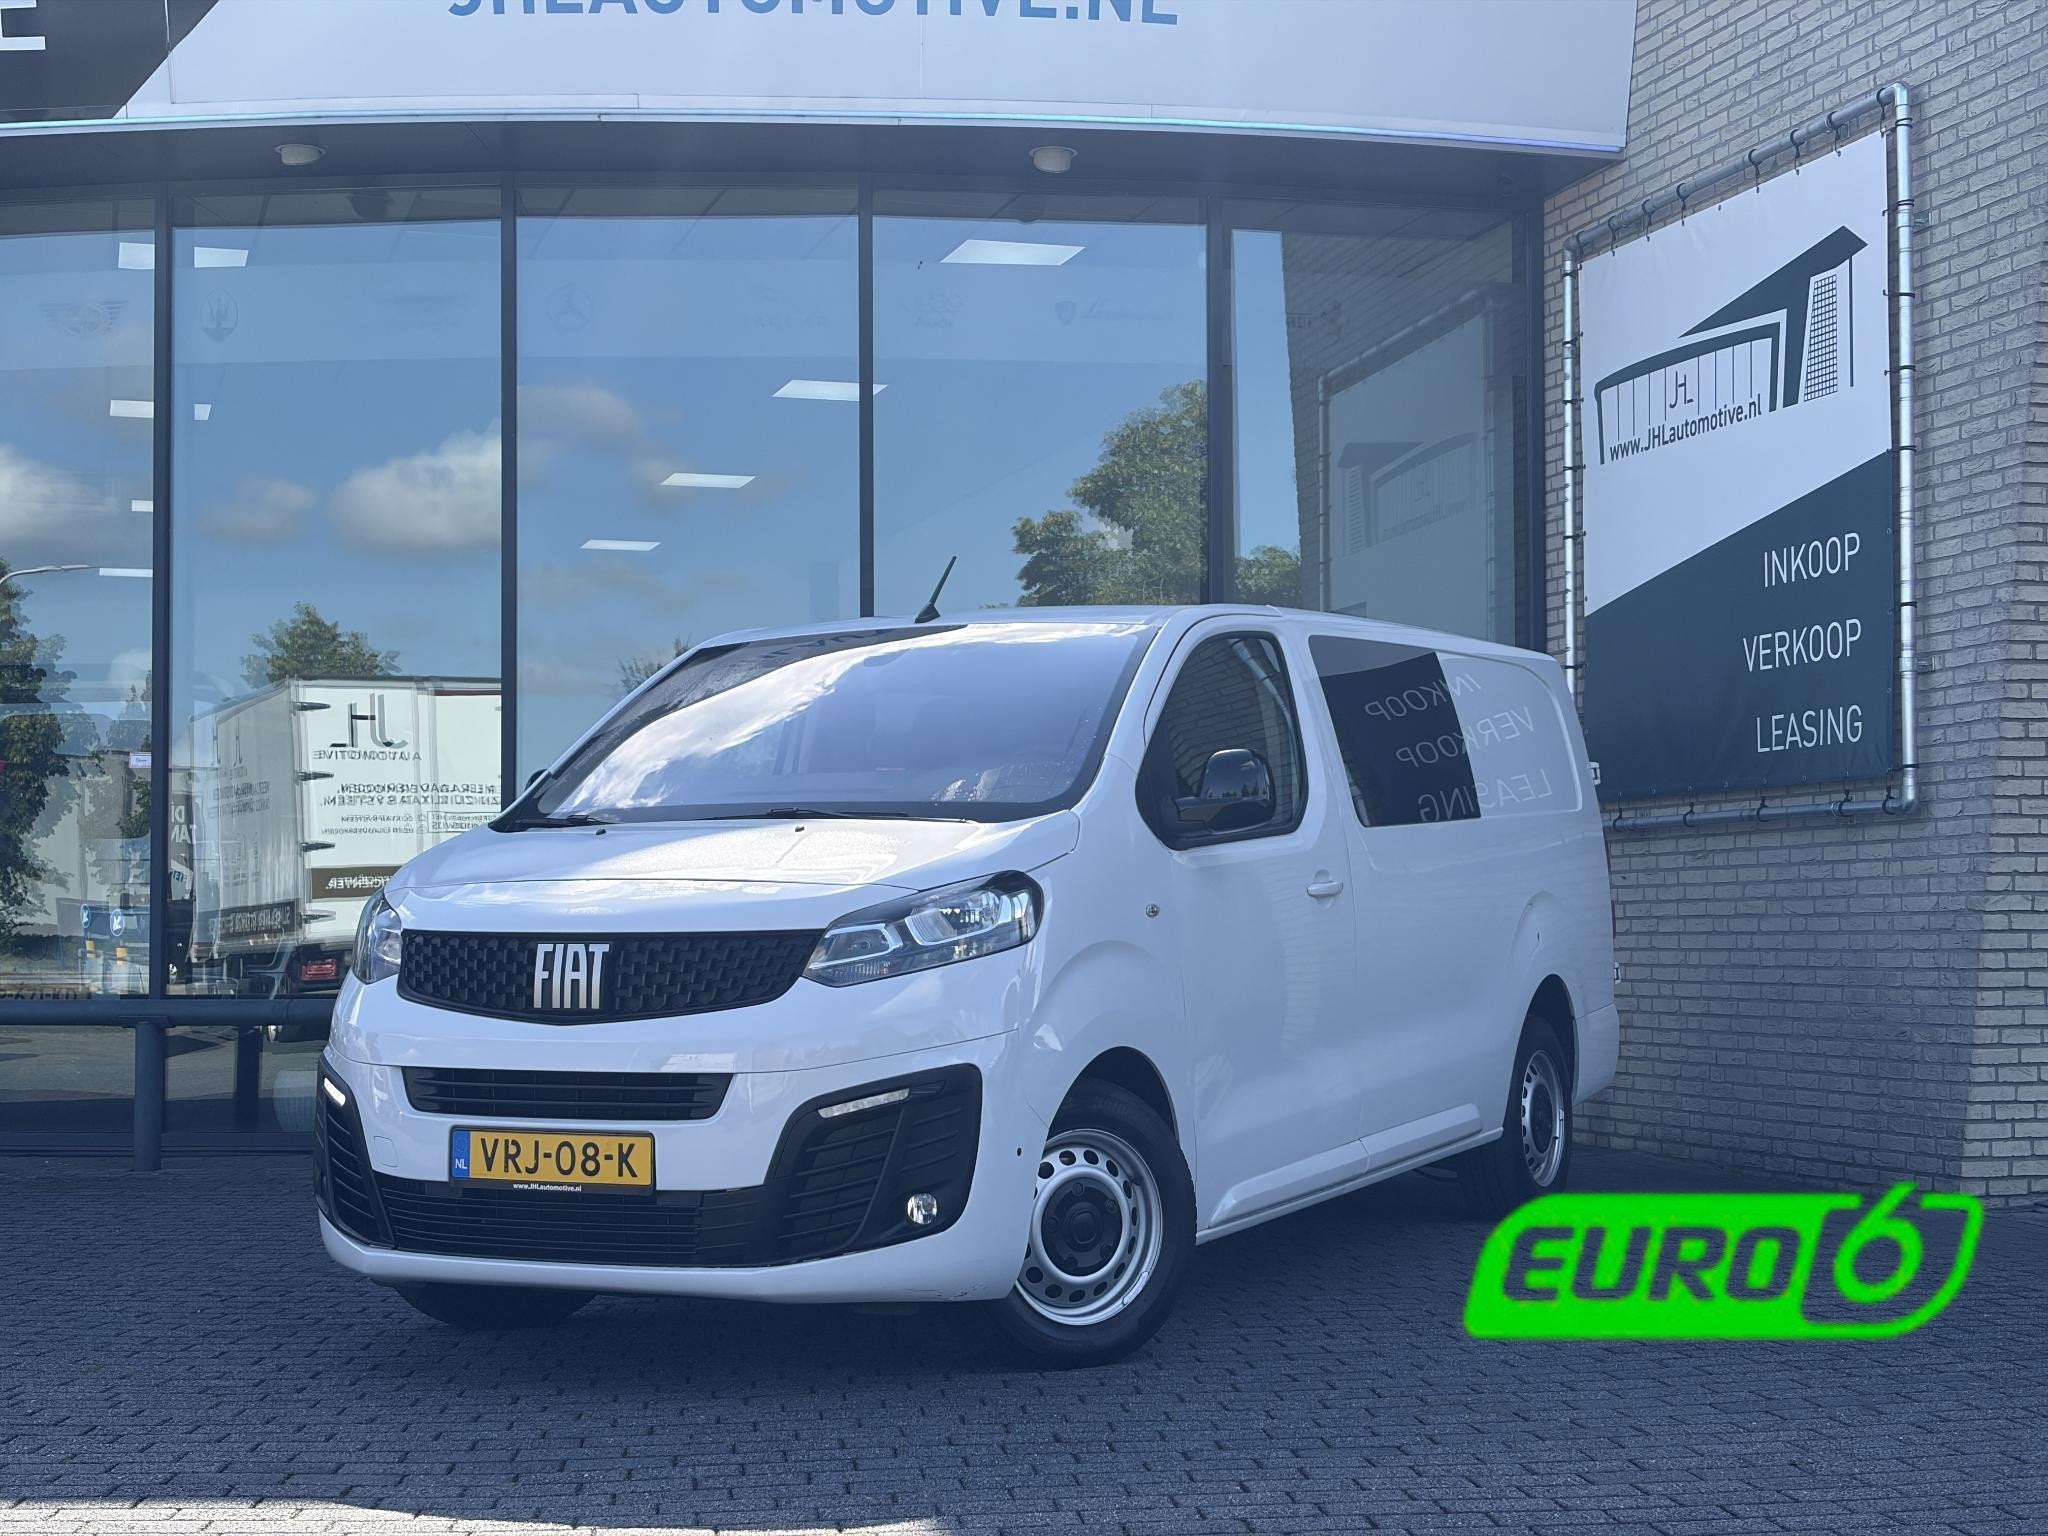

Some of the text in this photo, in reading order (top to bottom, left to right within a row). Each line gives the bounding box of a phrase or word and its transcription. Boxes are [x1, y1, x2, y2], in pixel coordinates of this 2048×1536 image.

[1609, 393, 1762, 462] www.JHLautomotive.nl
[1764, 532, 1860, 588] INKOOP
[1743, 618, 1862, 672] VERKOOP
[1756, 704, 1862, 753] LEASING
[533, 943, 610, 1010] FIAT
[455, 1137, 638, 1178] NL VRJ-08-K
[512, 1182, 583, 1192] www.JHLautomotive.nl
